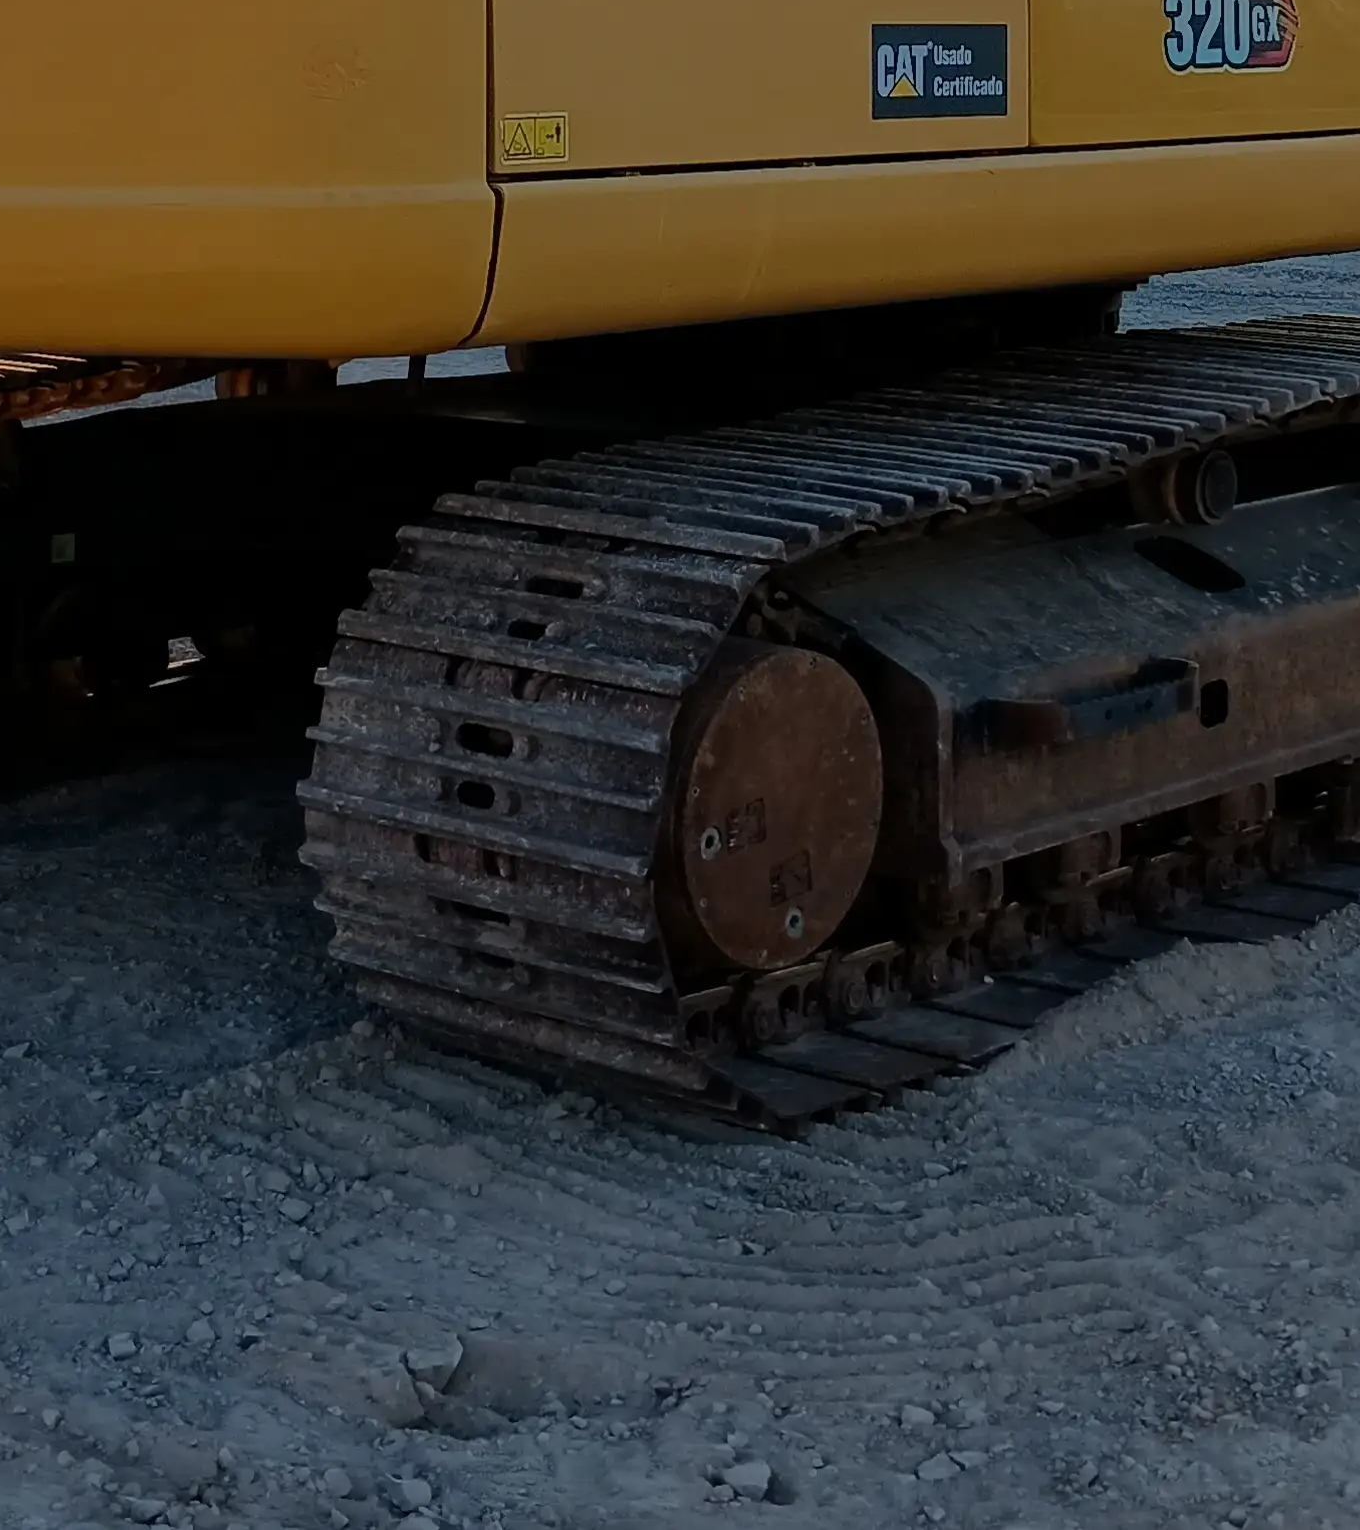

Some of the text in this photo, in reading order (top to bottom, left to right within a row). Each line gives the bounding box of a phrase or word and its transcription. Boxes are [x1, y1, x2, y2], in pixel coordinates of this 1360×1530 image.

[1251, 5, 1282, 43] GX
[933, 45, 972, 66] Usado
[877, 44, 929, 98] CAT
[933, 75, 1003, 97] Certificado
